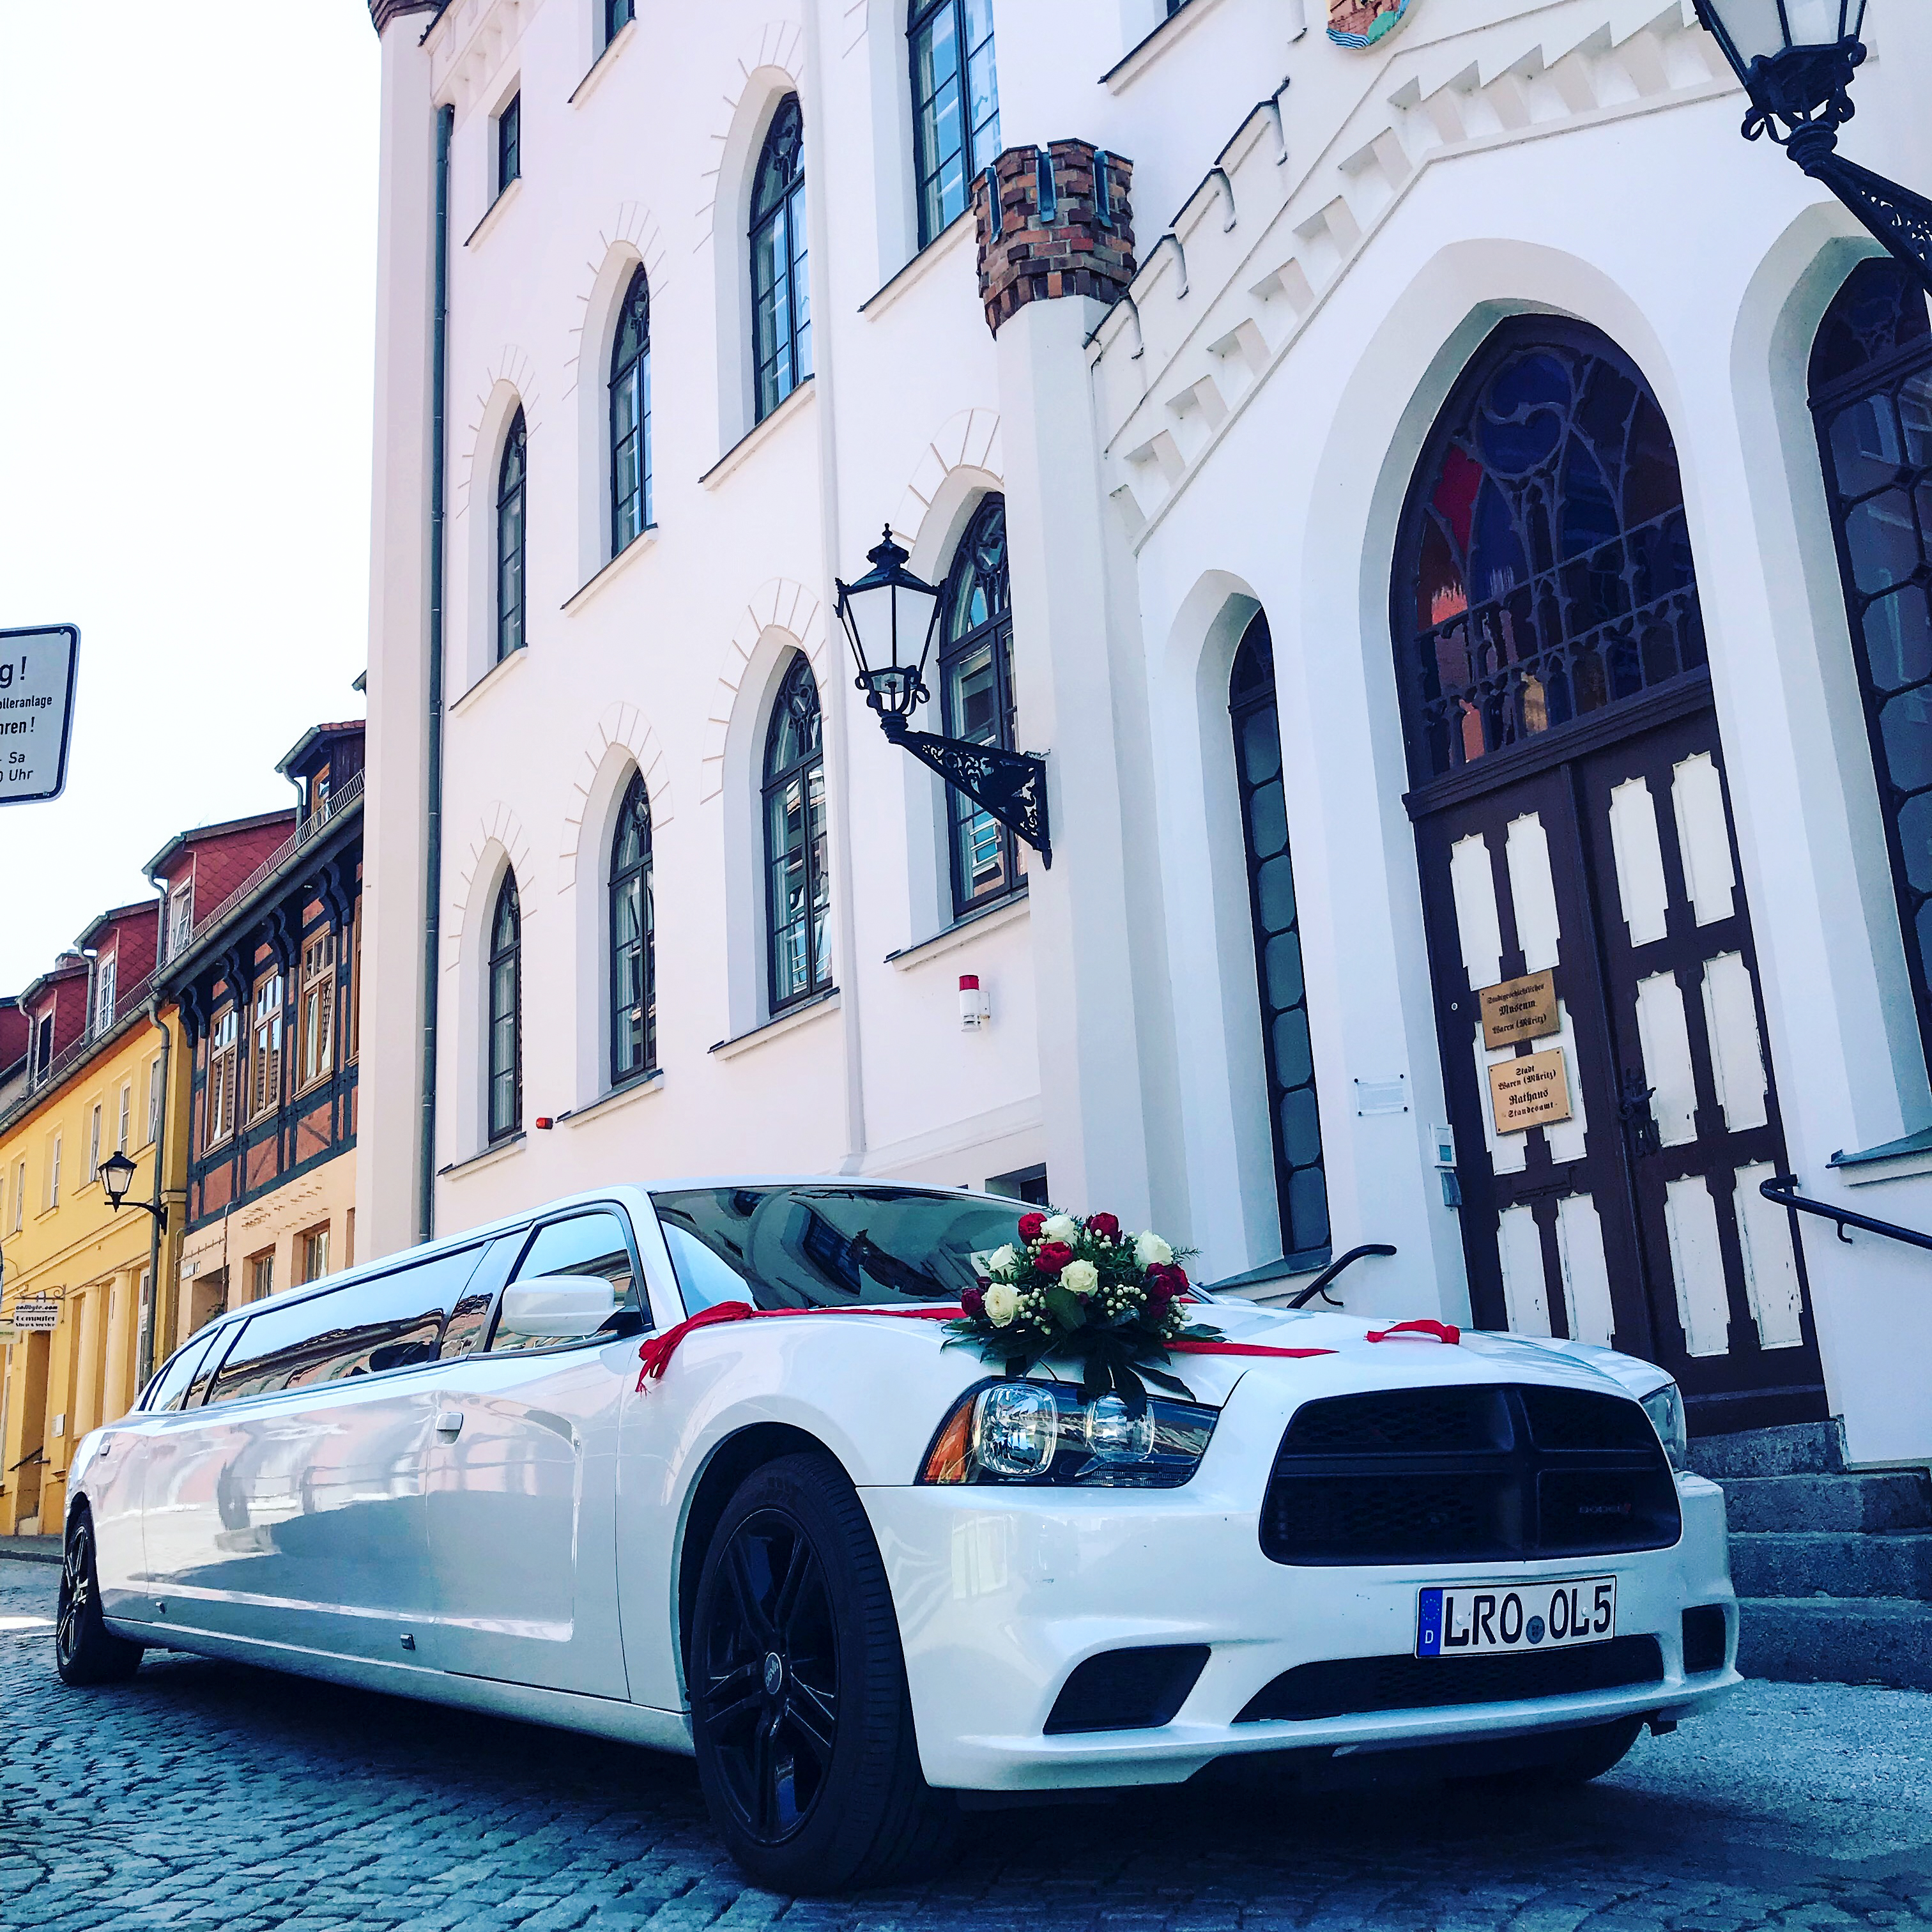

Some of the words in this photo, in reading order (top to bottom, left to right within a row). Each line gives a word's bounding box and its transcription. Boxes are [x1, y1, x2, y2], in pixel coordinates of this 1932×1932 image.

[8, 751, 26, 763] Sa
[9, 769, 34, 781] Uhr
[1499, 1000, 1536, 1016] Museum
[1492, 1023, 1515, 1034] Waren
[1515, 1065, 1535, 1076] Stadt
[1498, 1080, 1521, 1090] Waren
[1508, 1088, 1549, 1106] Rathaus
[1508, 1101, 1554, 1118] Standesamt
[1444, 1592, 1523, 1647] LRO
[1425, 1630, 1434, 1644] D
